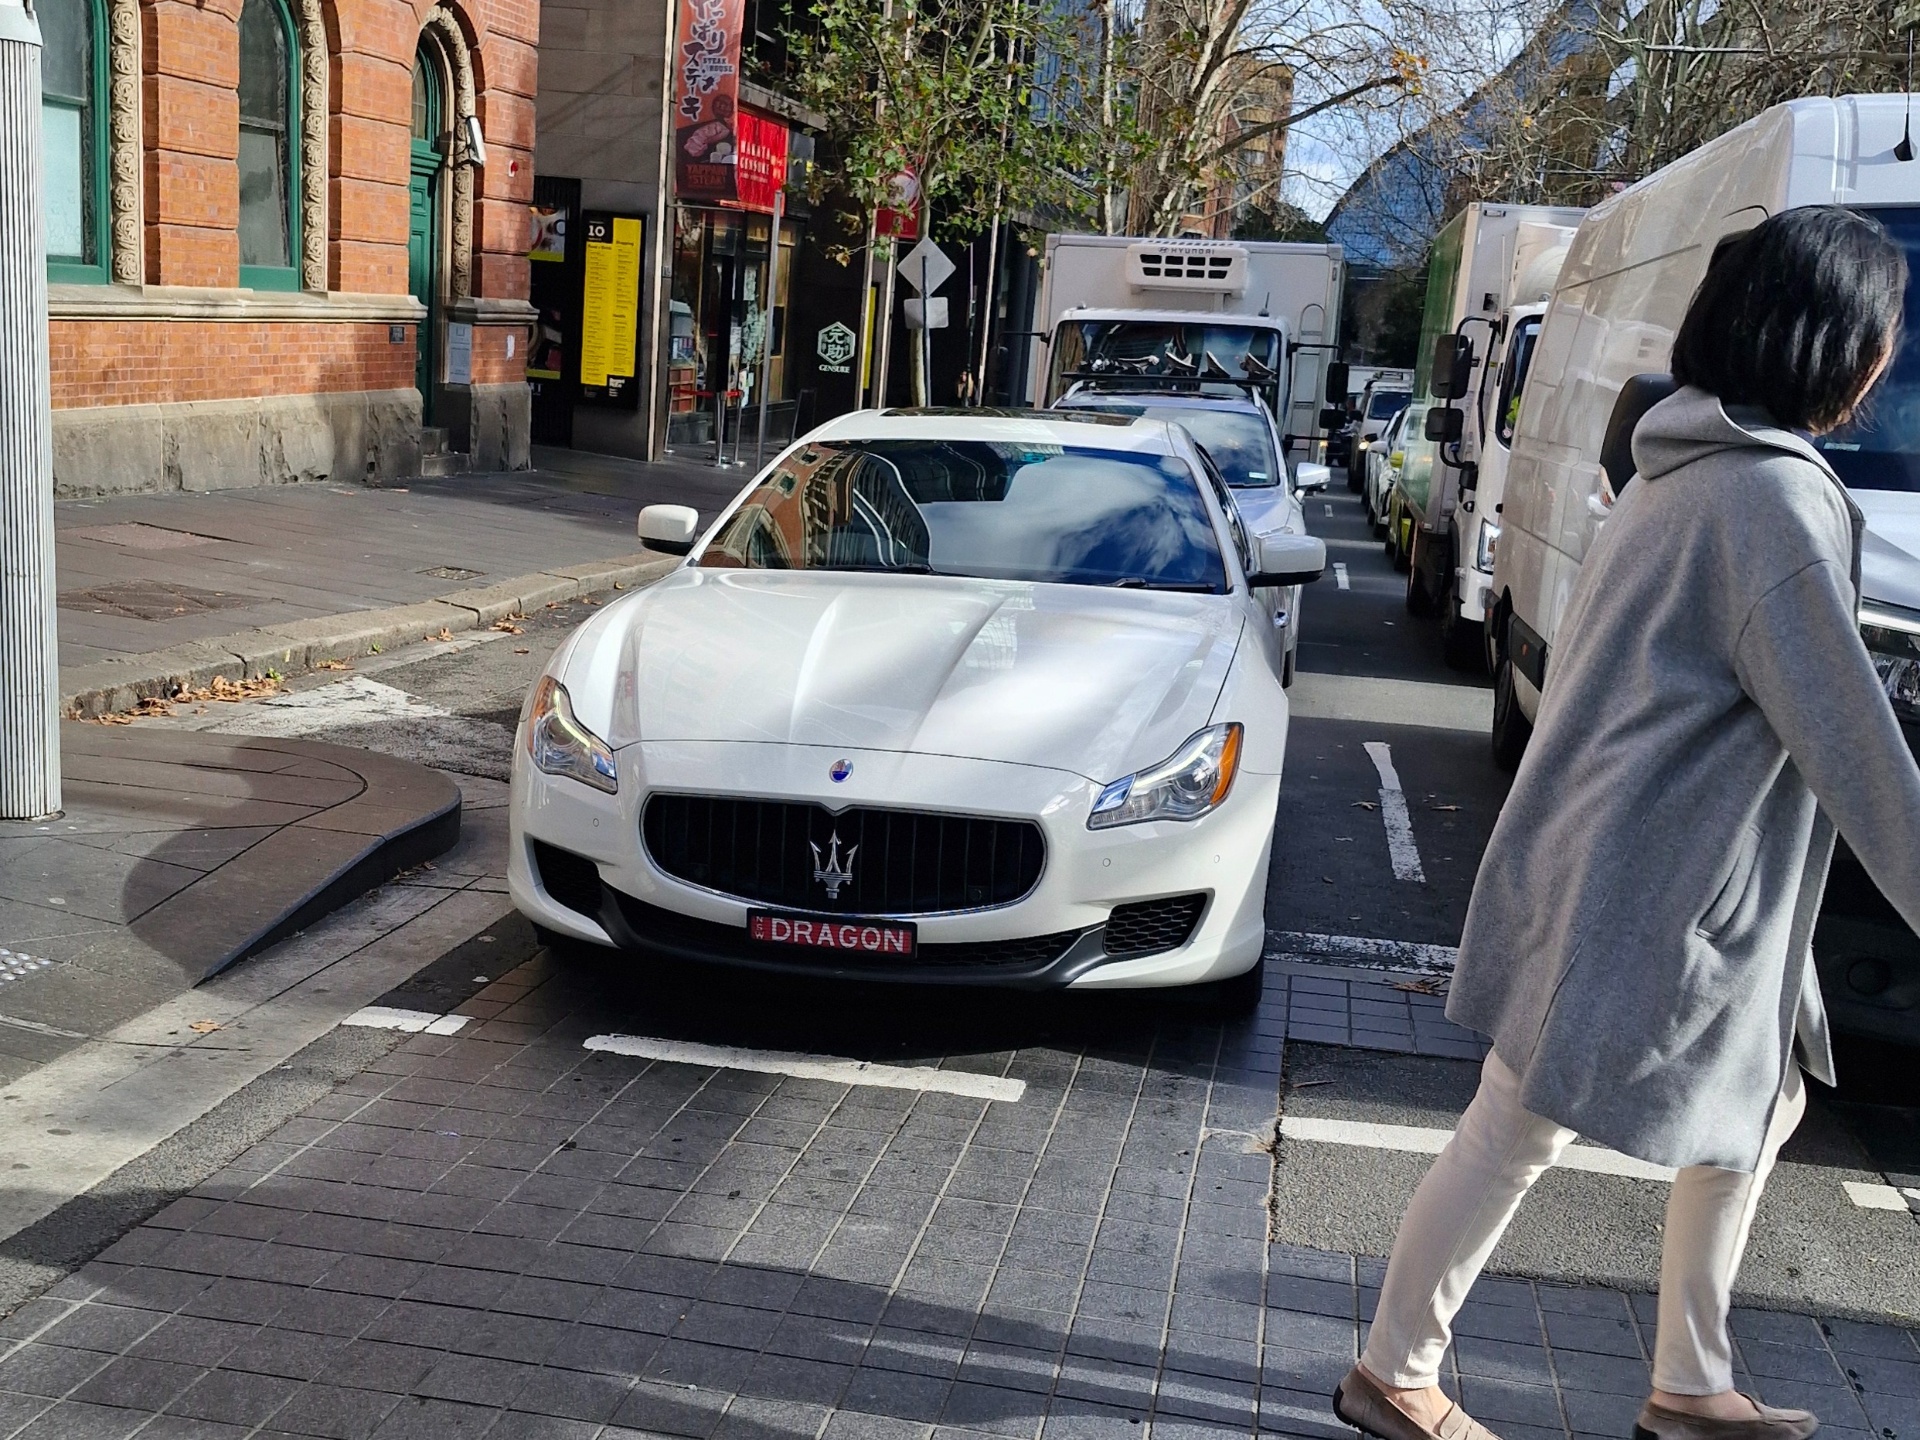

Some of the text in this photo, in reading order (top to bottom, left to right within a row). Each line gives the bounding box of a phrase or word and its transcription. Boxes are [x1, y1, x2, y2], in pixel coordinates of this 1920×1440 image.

[703, 57, 727, 65] STEAK
[740, 156, 770, 175] GENSUKE
[588, 225, 606, 237] 10
[826, 328, 846, 359] 元助
[818, 363, 851, 374] GENSUKE
